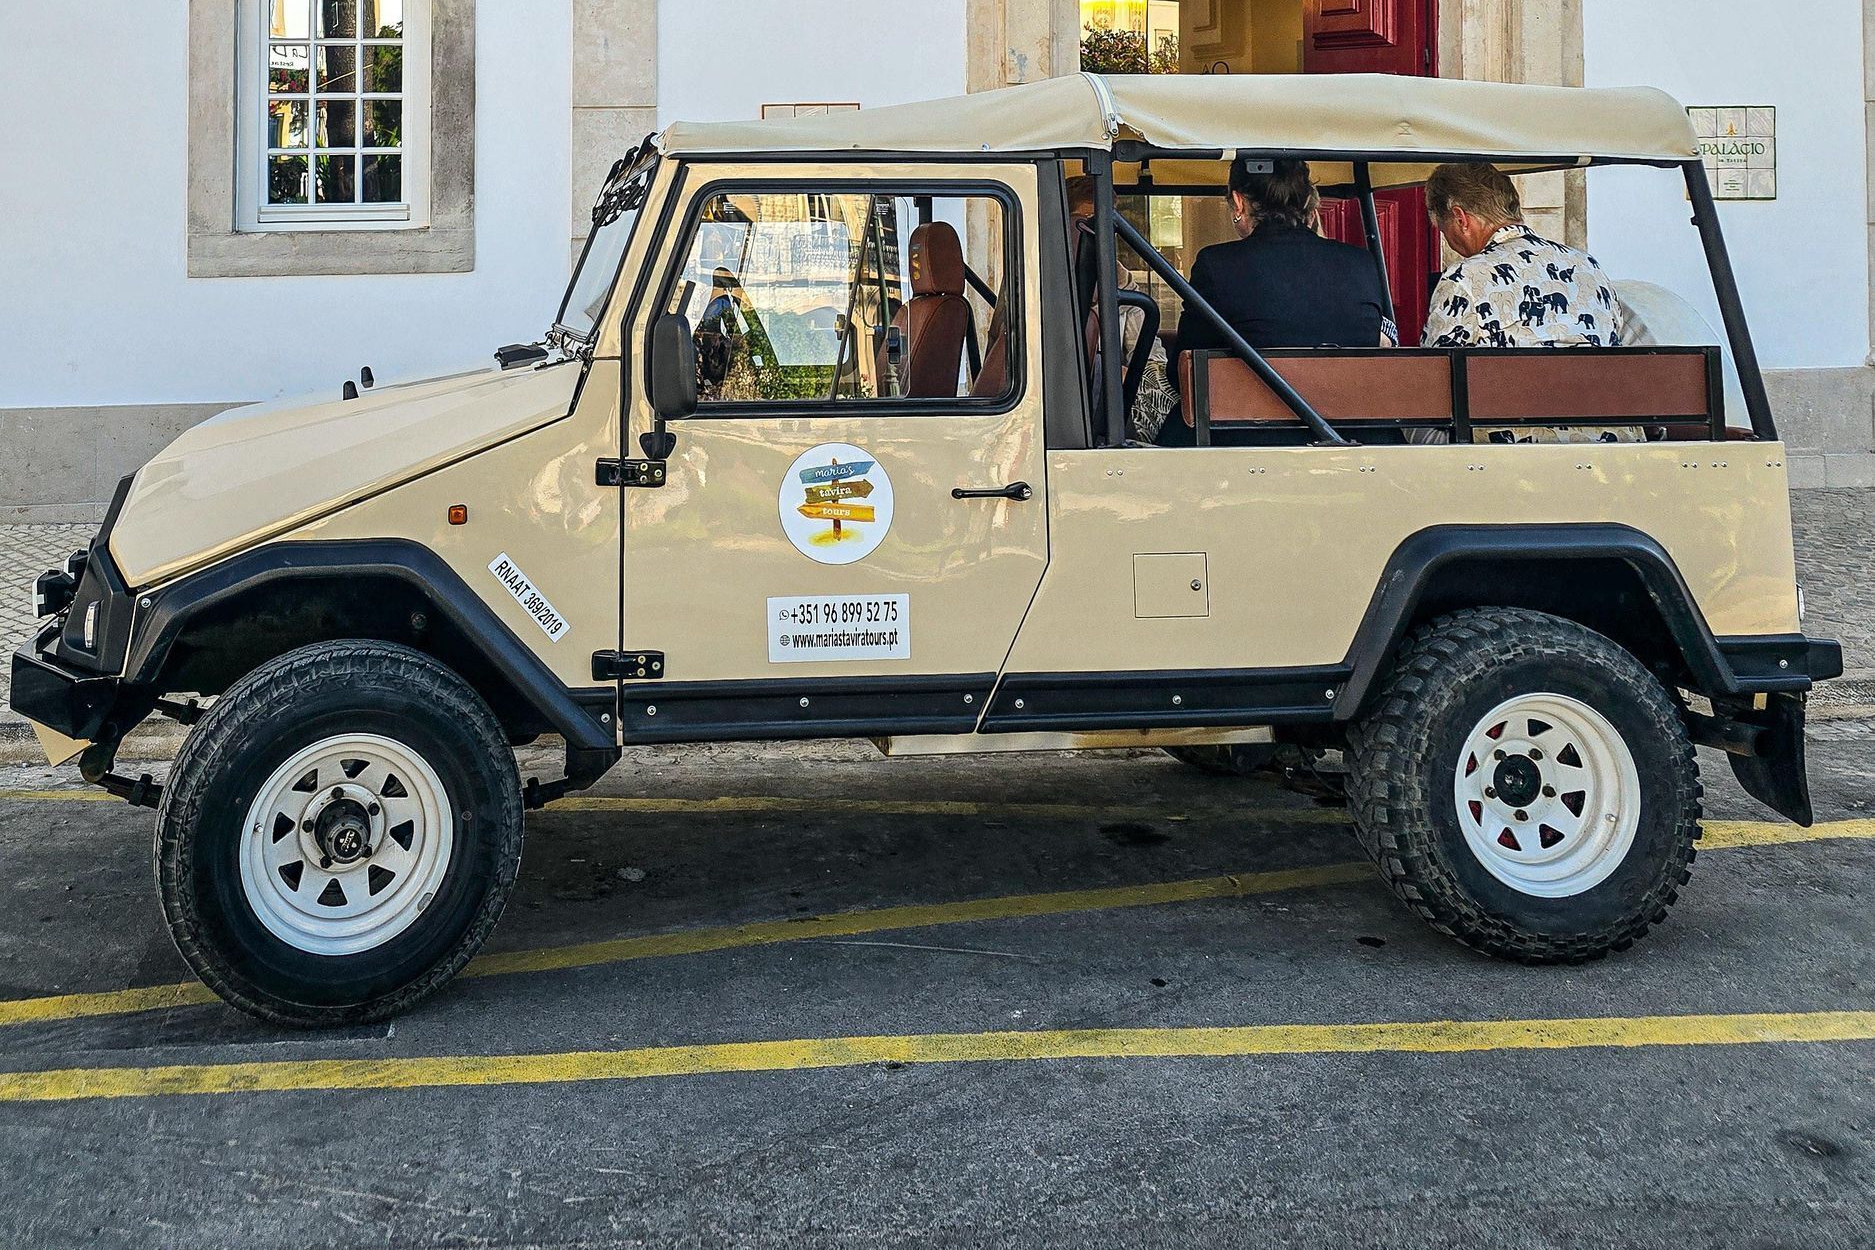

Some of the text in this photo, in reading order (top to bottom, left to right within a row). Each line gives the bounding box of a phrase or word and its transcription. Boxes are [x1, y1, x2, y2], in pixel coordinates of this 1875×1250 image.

[815, 464, 855, 478] maria's
[819, 486, 852, 497] tavira
[822, 505, 850, 517] tours
[494, 560, 563, 635] RNAAT 369/2019
[790, 601, 898, 624] +351 96 899 52 75
[792, 627, 898, 651] www.mariastaviratours.pt
